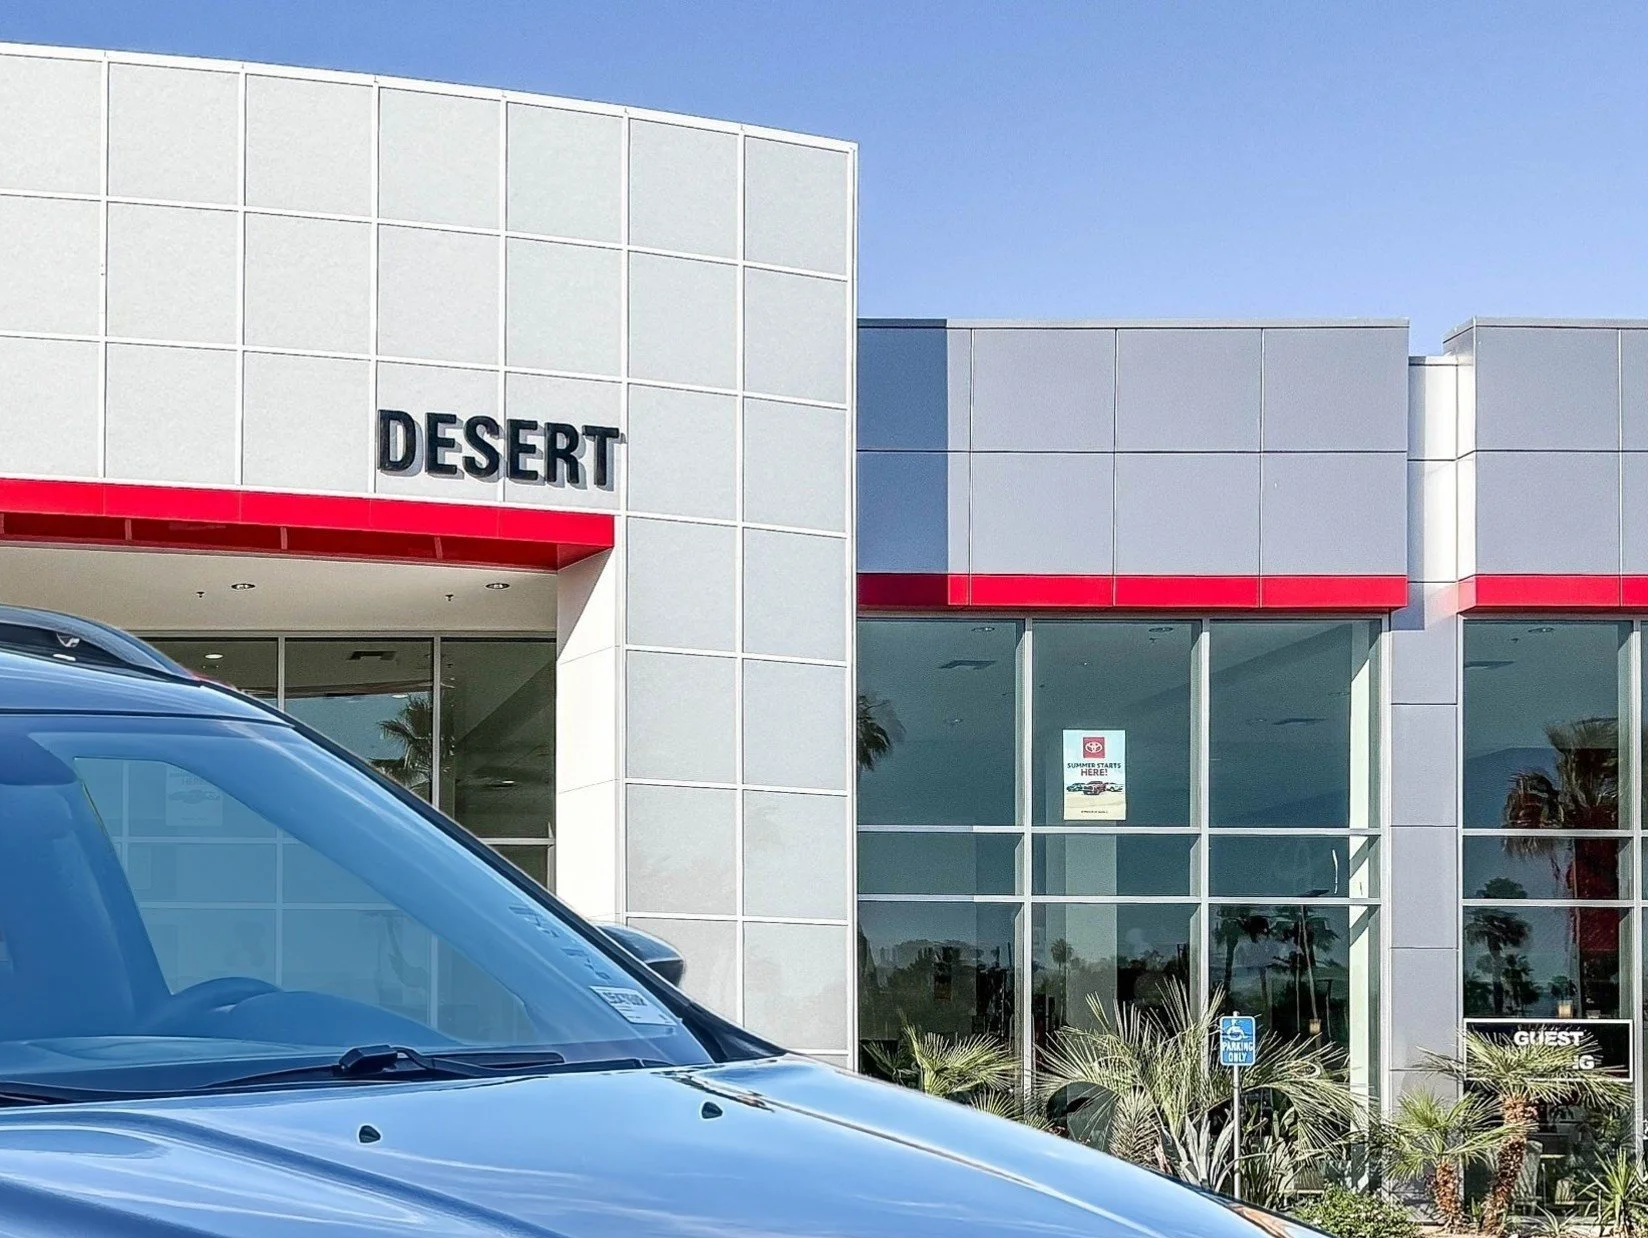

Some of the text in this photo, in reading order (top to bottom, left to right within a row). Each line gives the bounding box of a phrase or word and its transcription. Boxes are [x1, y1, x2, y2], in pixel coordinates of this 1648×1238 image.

[377, 408, 621, 488] DESERT
[1080, 768, 1108, 776] HERE!
[1513, 1030, 1585, 1047] GUEST
[1222, 1041, 1254, 1052] PARKING
[1228, 1051, 1248, 1062] ONLY
